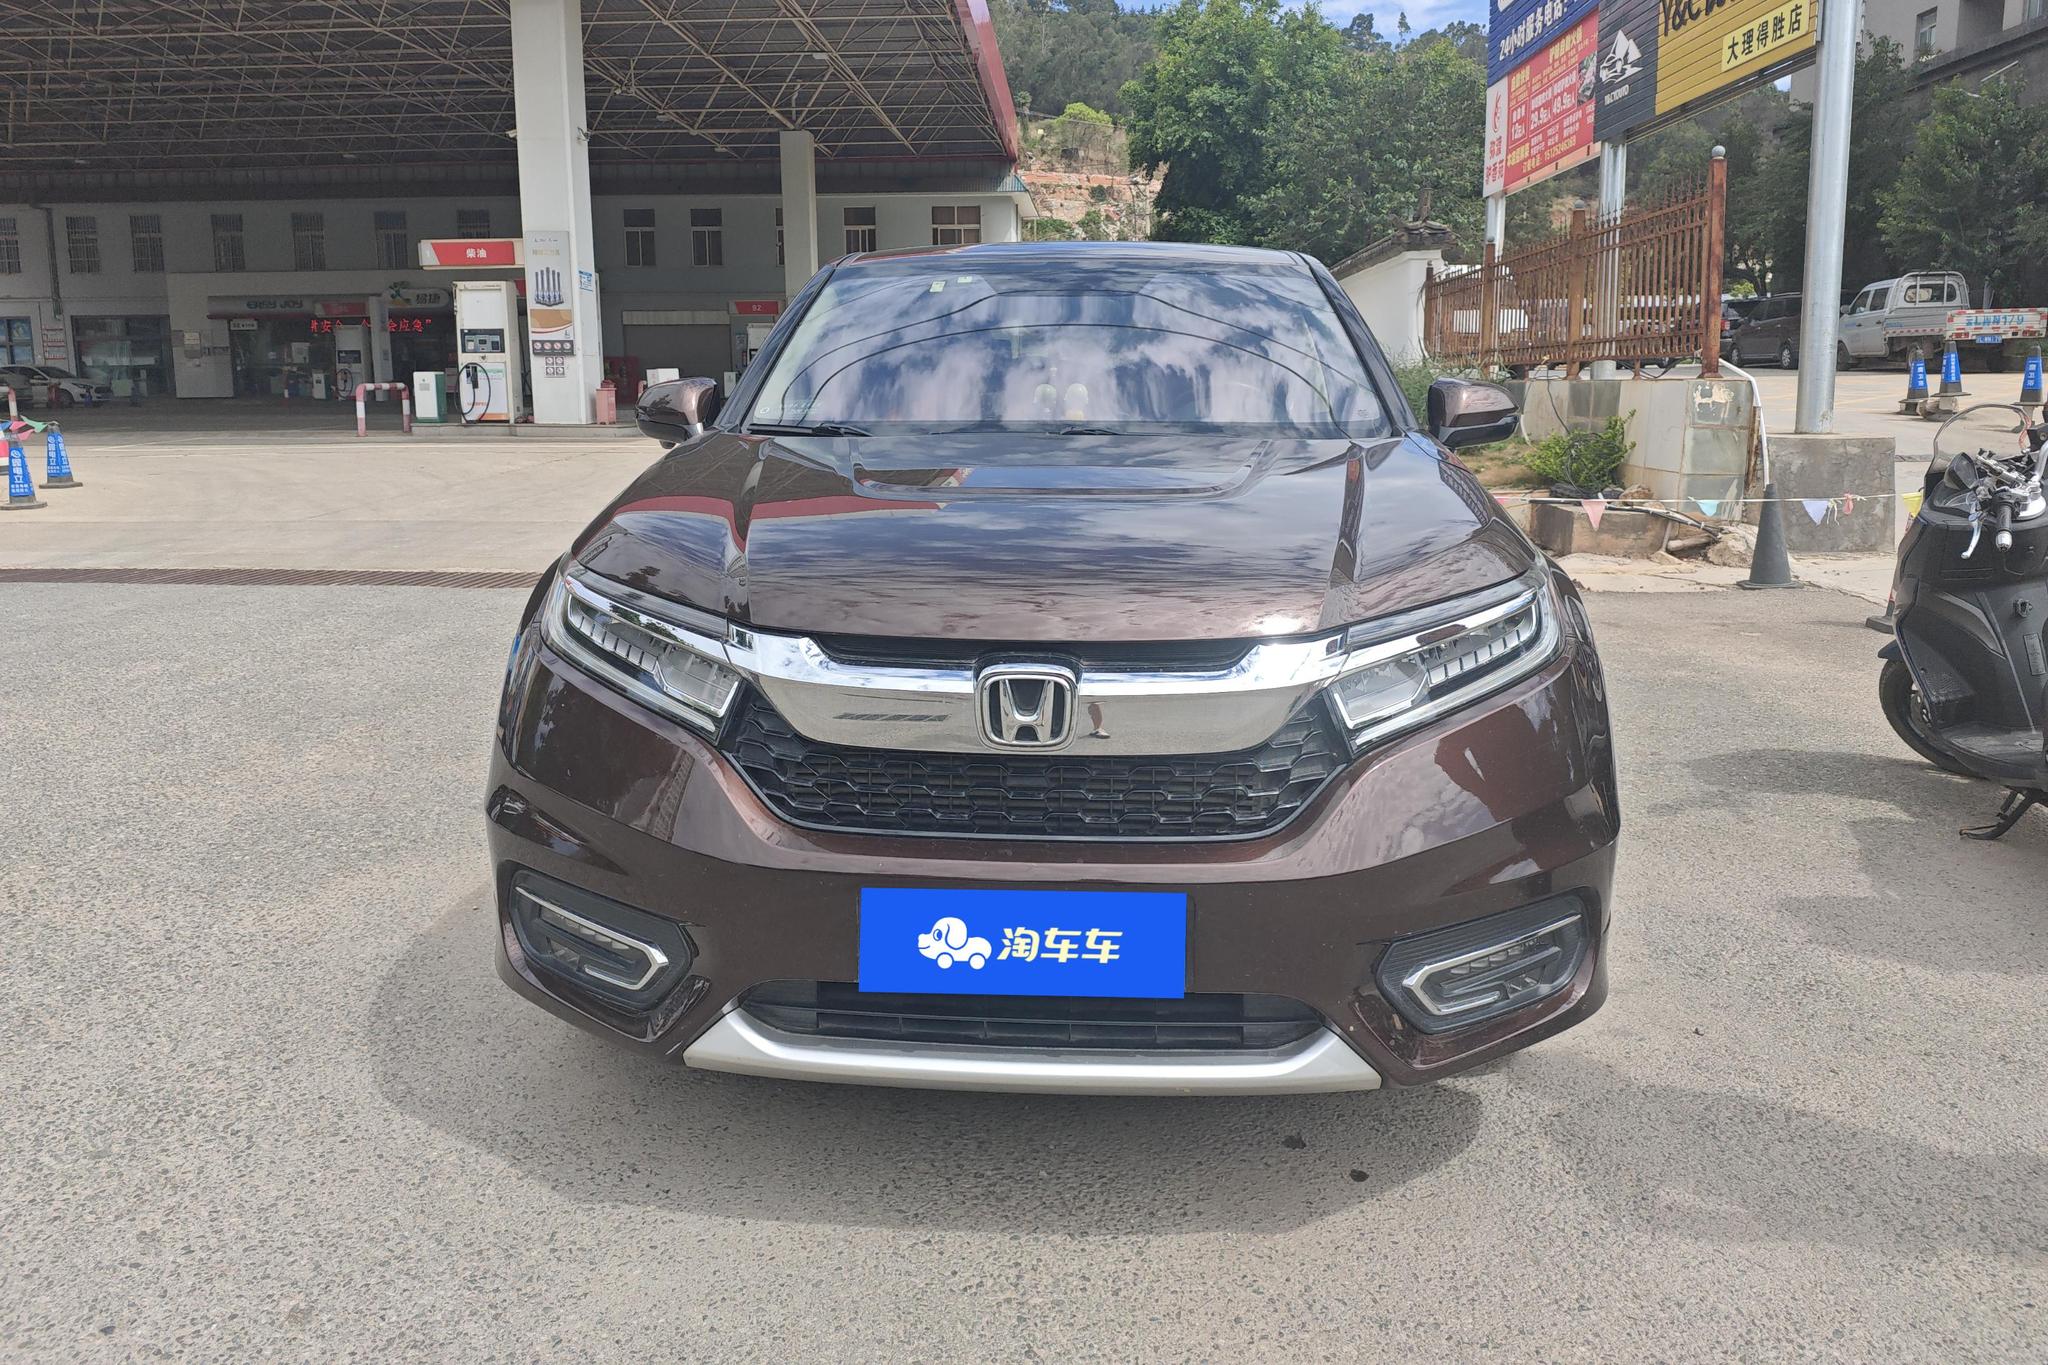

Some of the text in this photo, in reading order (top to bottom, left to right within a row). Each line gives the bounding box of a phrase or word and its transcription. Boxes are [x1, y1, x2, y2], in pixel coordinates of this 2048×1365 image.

[1726, 4, 1803, 65] 大理得胜店
[466, 248, 487, 258] 柴油
